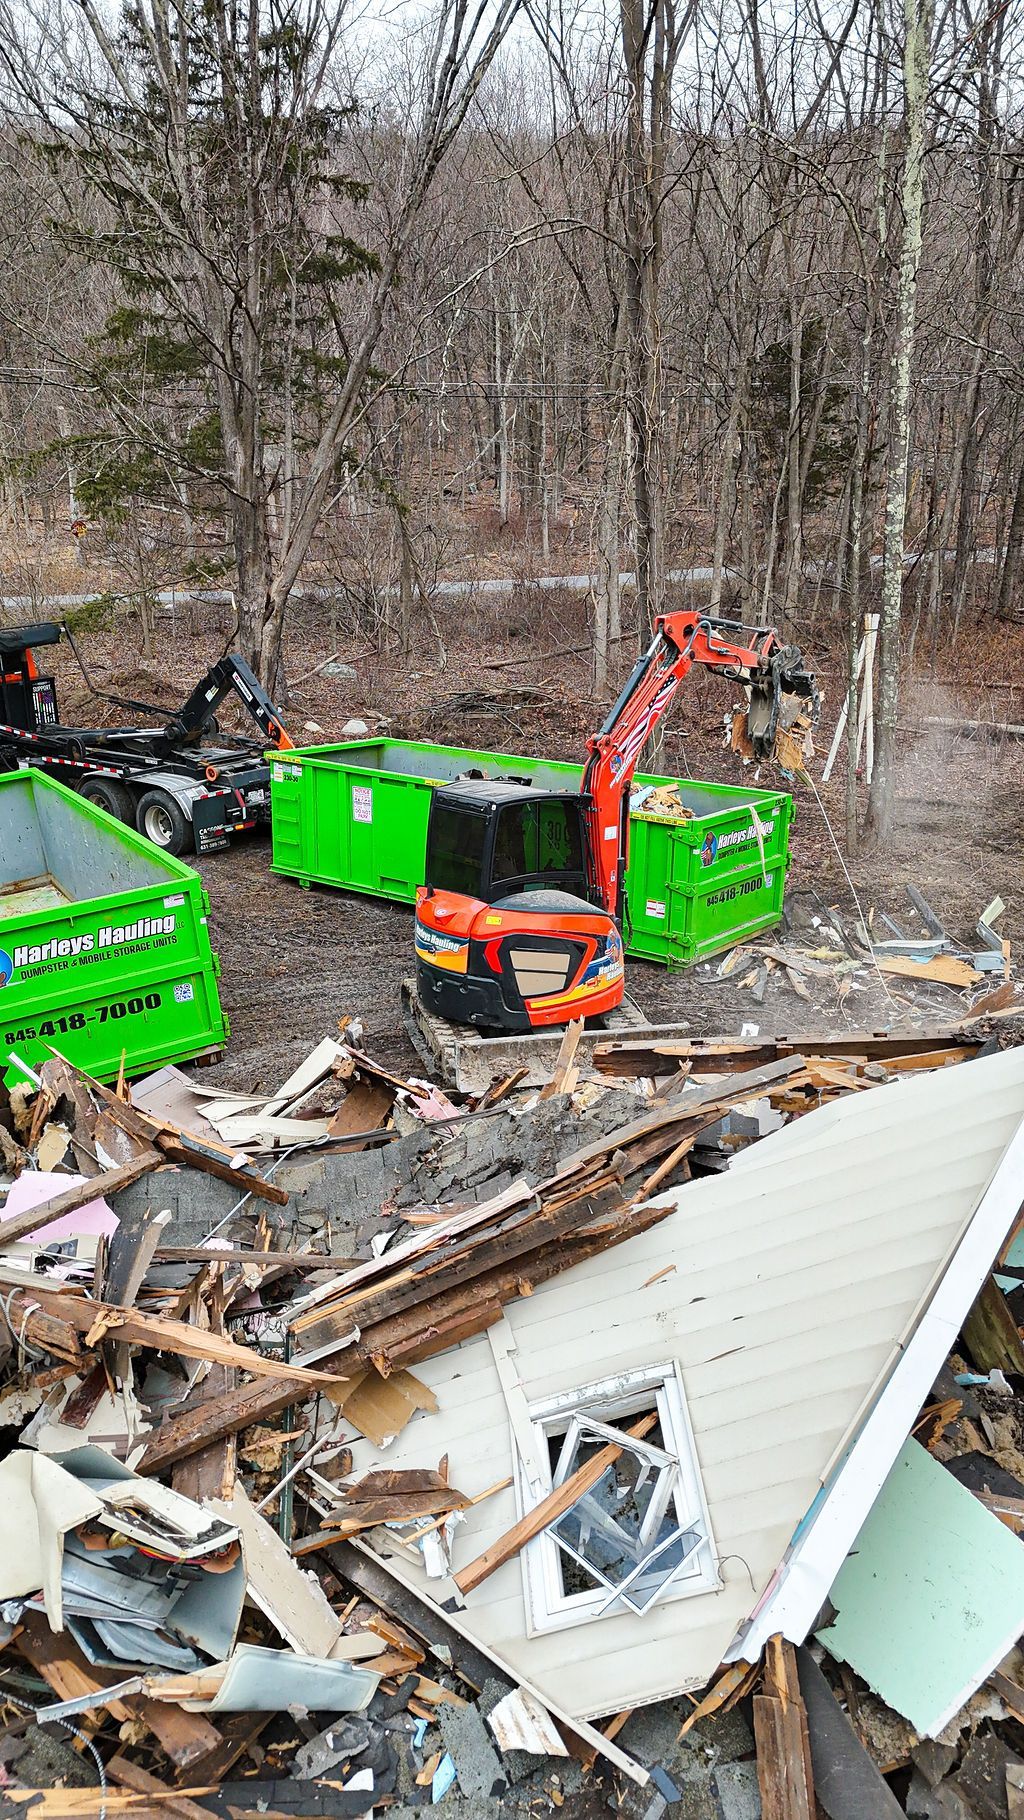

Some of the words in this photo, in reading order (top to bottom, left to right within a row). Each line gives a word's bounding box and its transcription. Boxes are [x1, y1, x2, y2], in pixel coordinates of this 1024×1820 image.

[717, 828, 747, 850] Harleys
[706, 895, 719, 907] 845
[719, 877, 763, 904] 418-7000
[13, 932, 95, 968] Harleys
[98, 913, 177, 948] Hauling
[20, 960, 69, 980] DUMPSTER
[71, 958, 78, 967] &
[78, 949, 112, 966] MOBILE
[114, 942, 151, 958] STORAGE
[153, 935, 178, 949] UNITS
[430, 934, 461, 953] Hauling
[4, 1027, 37, 1045] 845
[38, 993, 162, 1037] 418-7000
